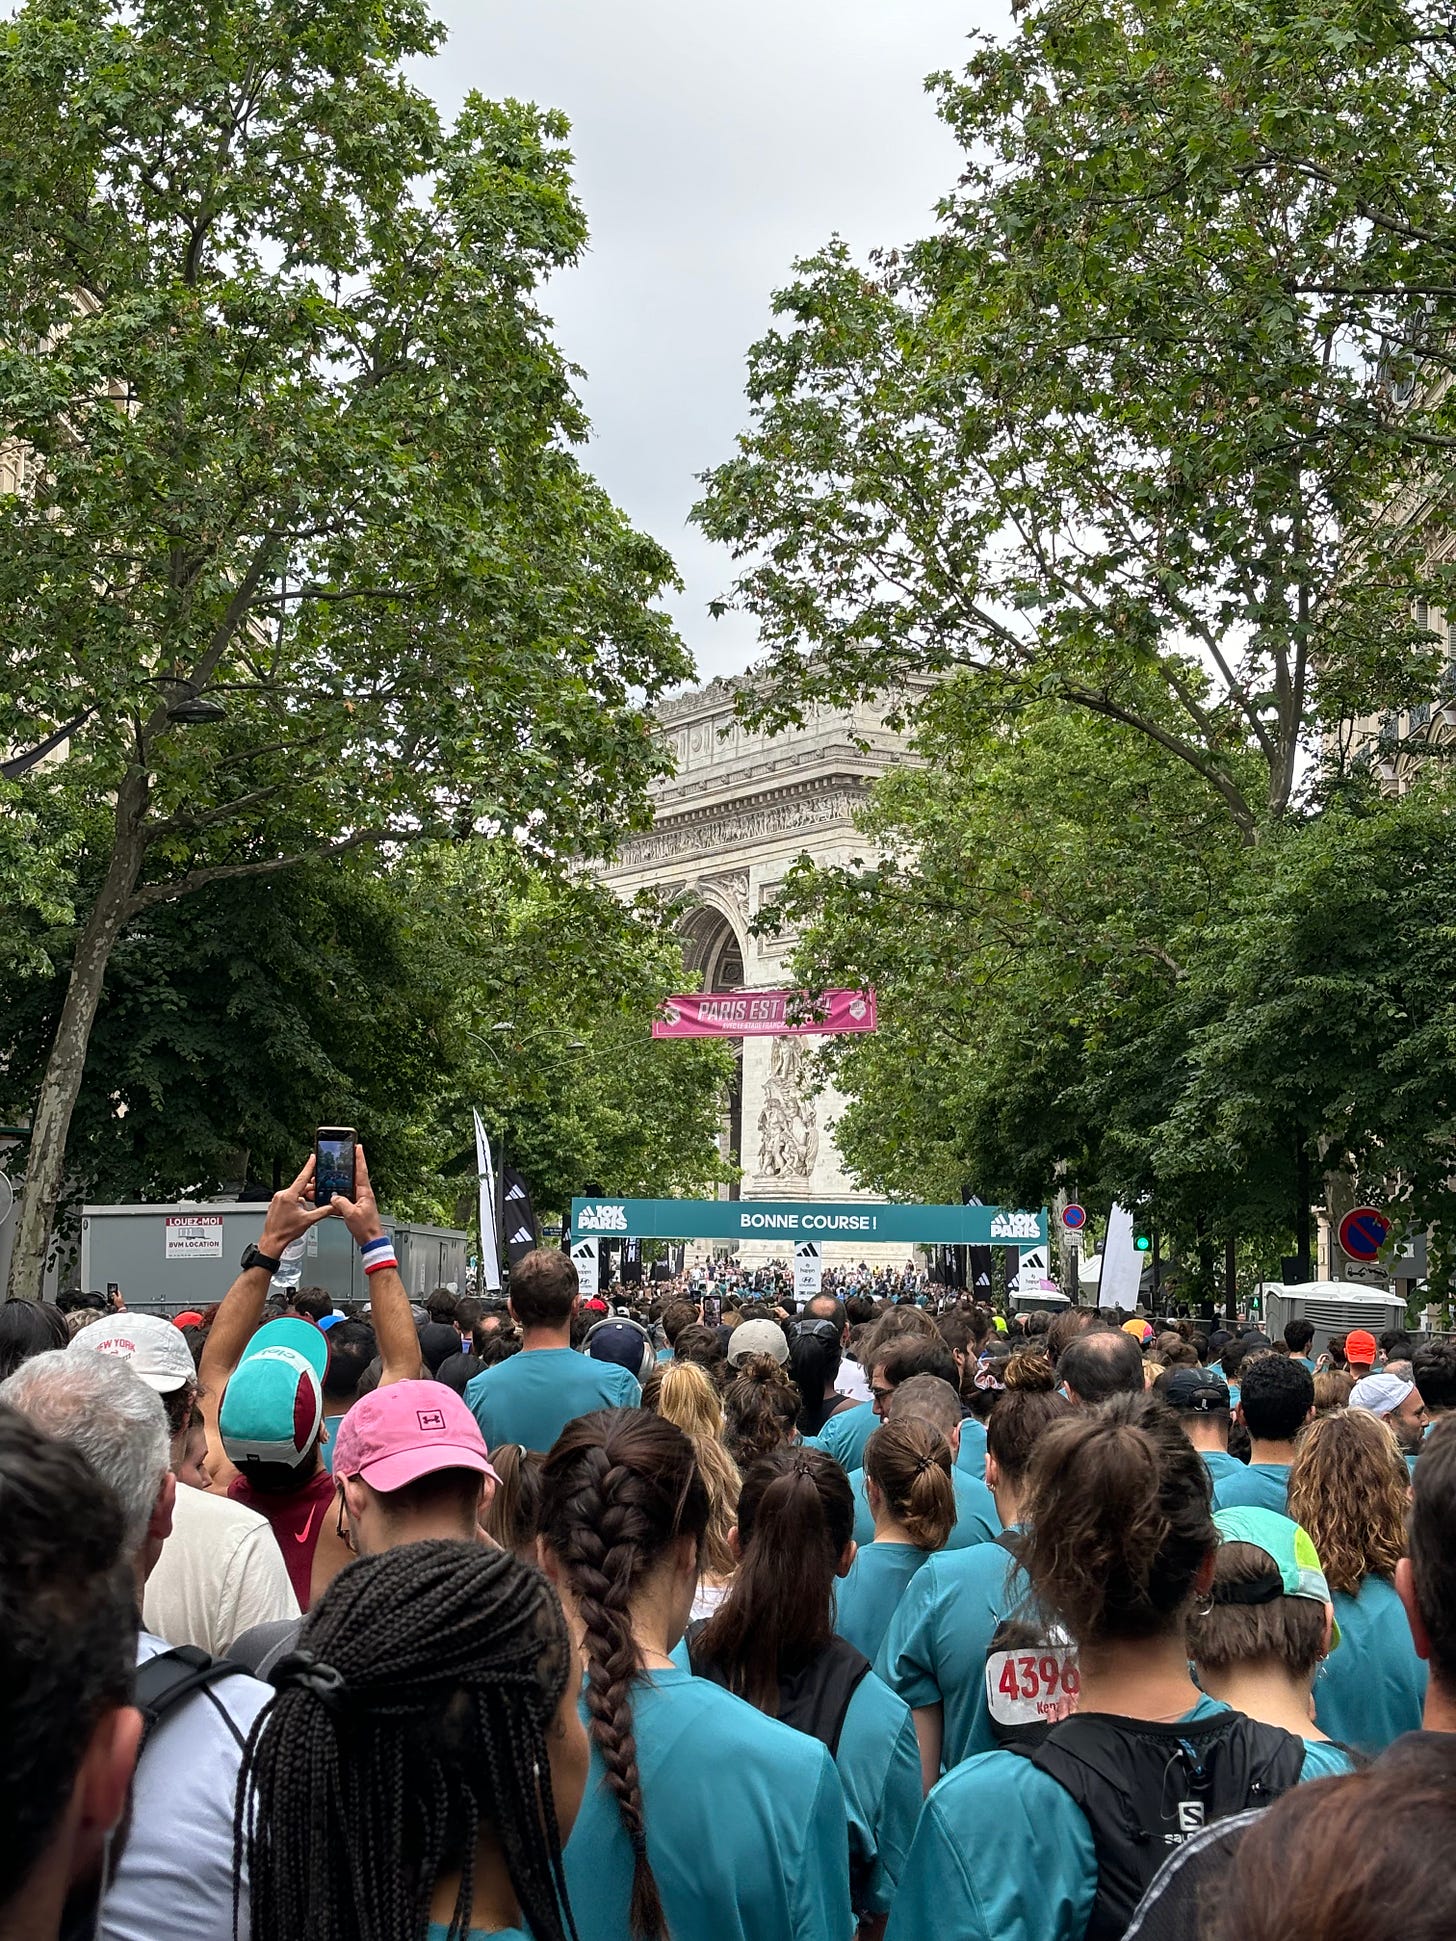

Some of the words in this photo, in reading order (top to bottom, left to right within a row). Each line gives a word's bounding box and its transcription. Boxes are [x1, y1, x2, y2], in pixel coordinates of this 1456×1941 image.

[697, 1000, 747, 1021] PARIS
[749, 999, 782, 1020] EST
[595, 1205, 625, 1218] 10K
[169, 1217, 220, 1226] LOUEZ-MOI
[578, 1217, 628, 1230] PARIS
[740, 1213, 799, 1228] BONNE
[801, 1215, 870, 1230] COURSE
[872, 1217, 877, 1230] !
[1008, 1213, 1038, 1226] 10K
[990, 1225, 1041, 1238] PARIS
[185, 1240, 220, 1248] LOCATION
[114, 1338, 136, 1352] YORK
[999, 1656, 1081, 1700] 4396
